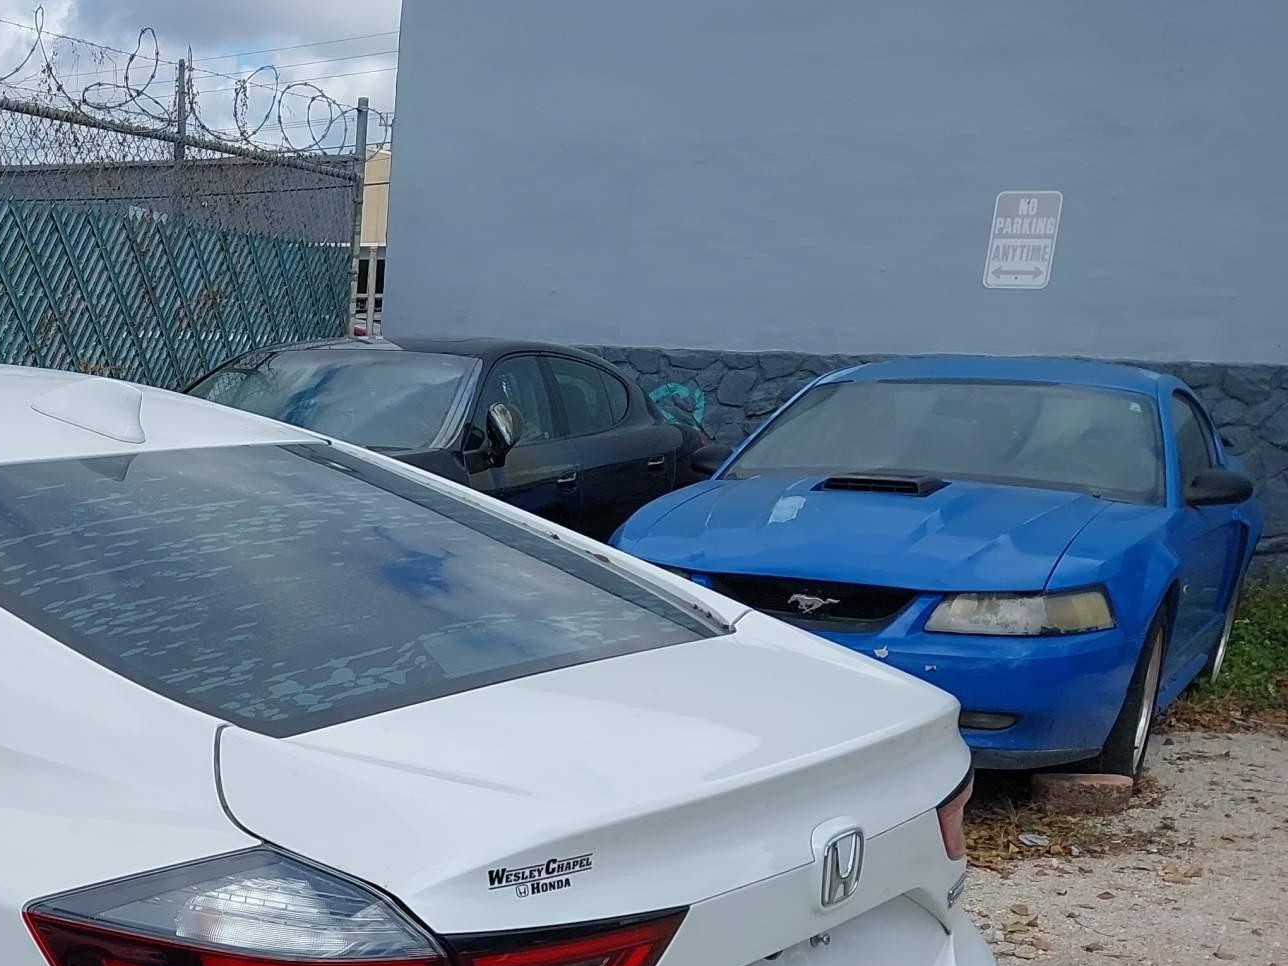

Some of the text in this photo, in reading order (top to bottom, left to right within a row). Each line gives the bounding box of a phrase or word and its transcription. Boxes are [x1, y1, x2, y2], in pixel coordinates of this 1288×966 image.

[1018, 198, 1039, 216] NO
[995, 217, 1056, 235] PARKING
[991, 244, 1050, 262] ANYTIME
[488, 857, 593, 886] WESLEY CHAPEL
[531, 877, 571, 895] HONDA
